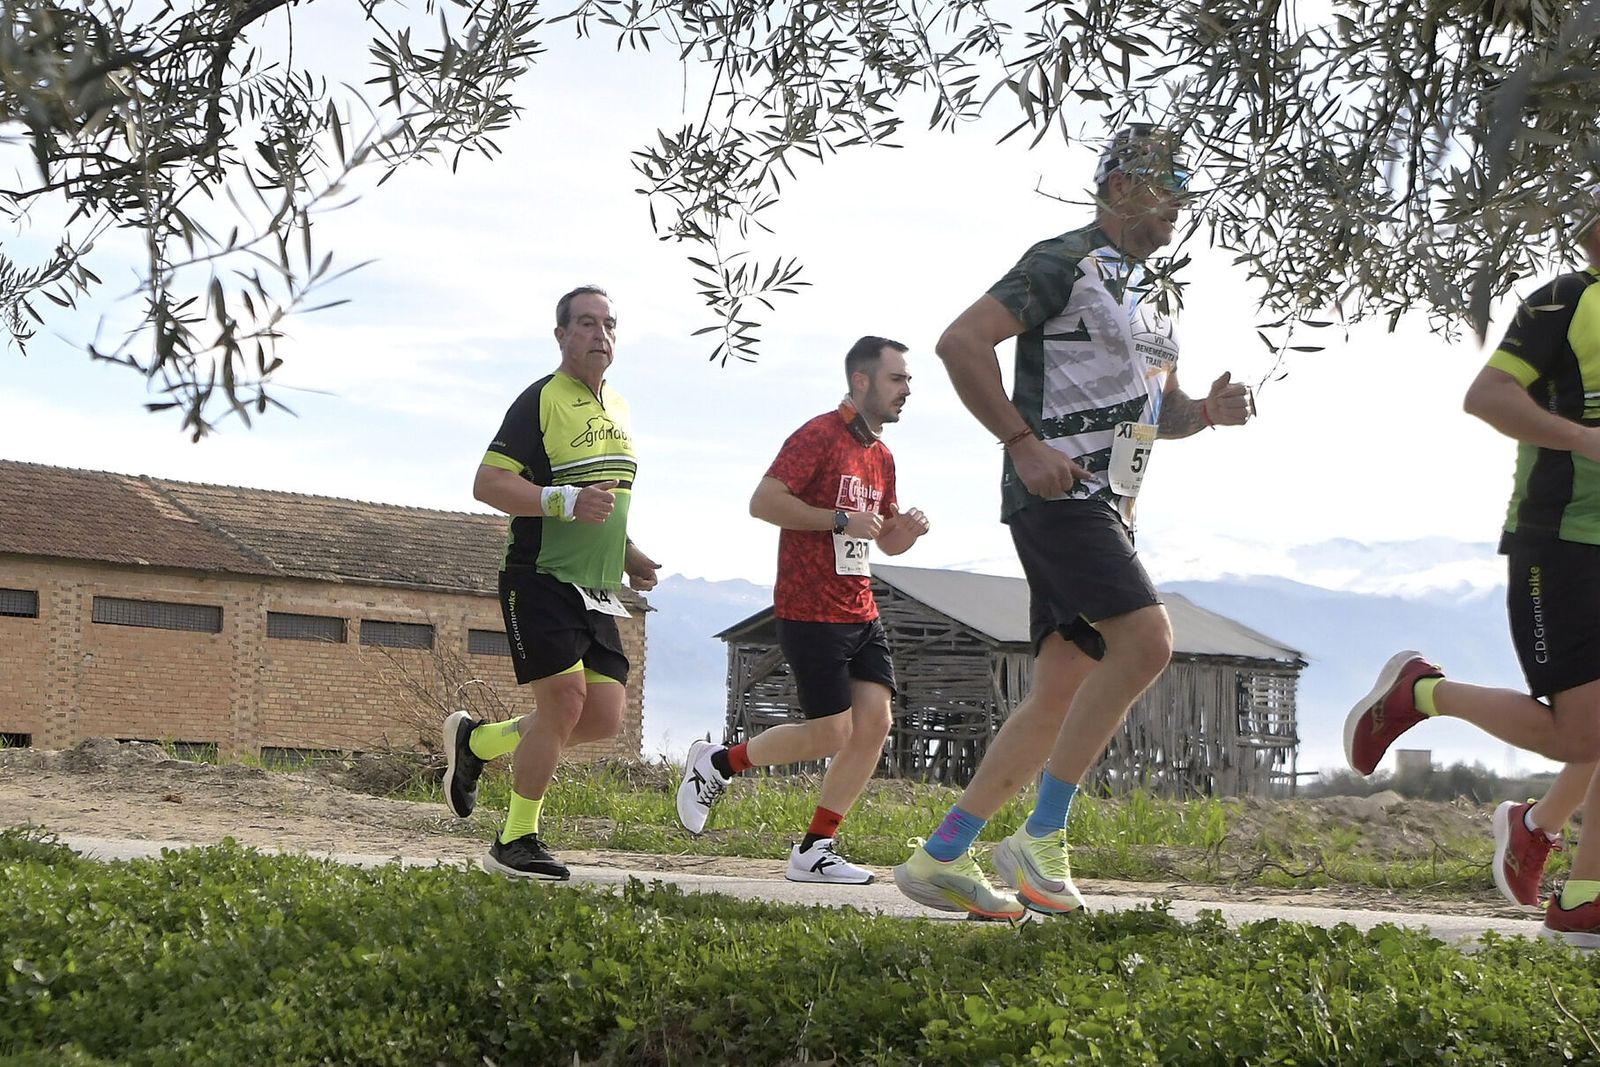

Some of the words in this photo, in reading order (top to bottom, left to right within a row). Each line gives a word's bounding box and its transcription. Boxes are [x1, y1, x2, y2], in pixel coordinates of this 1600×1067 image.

[1154, 336, 1165, 345] VII
[1145, 356, 1162, 368] TRAIL
[1117, 423, 1133, 439] XI
[844, 540, 870, 559] 237
[1528, 566, 1548, 664] C.D.Granabike
